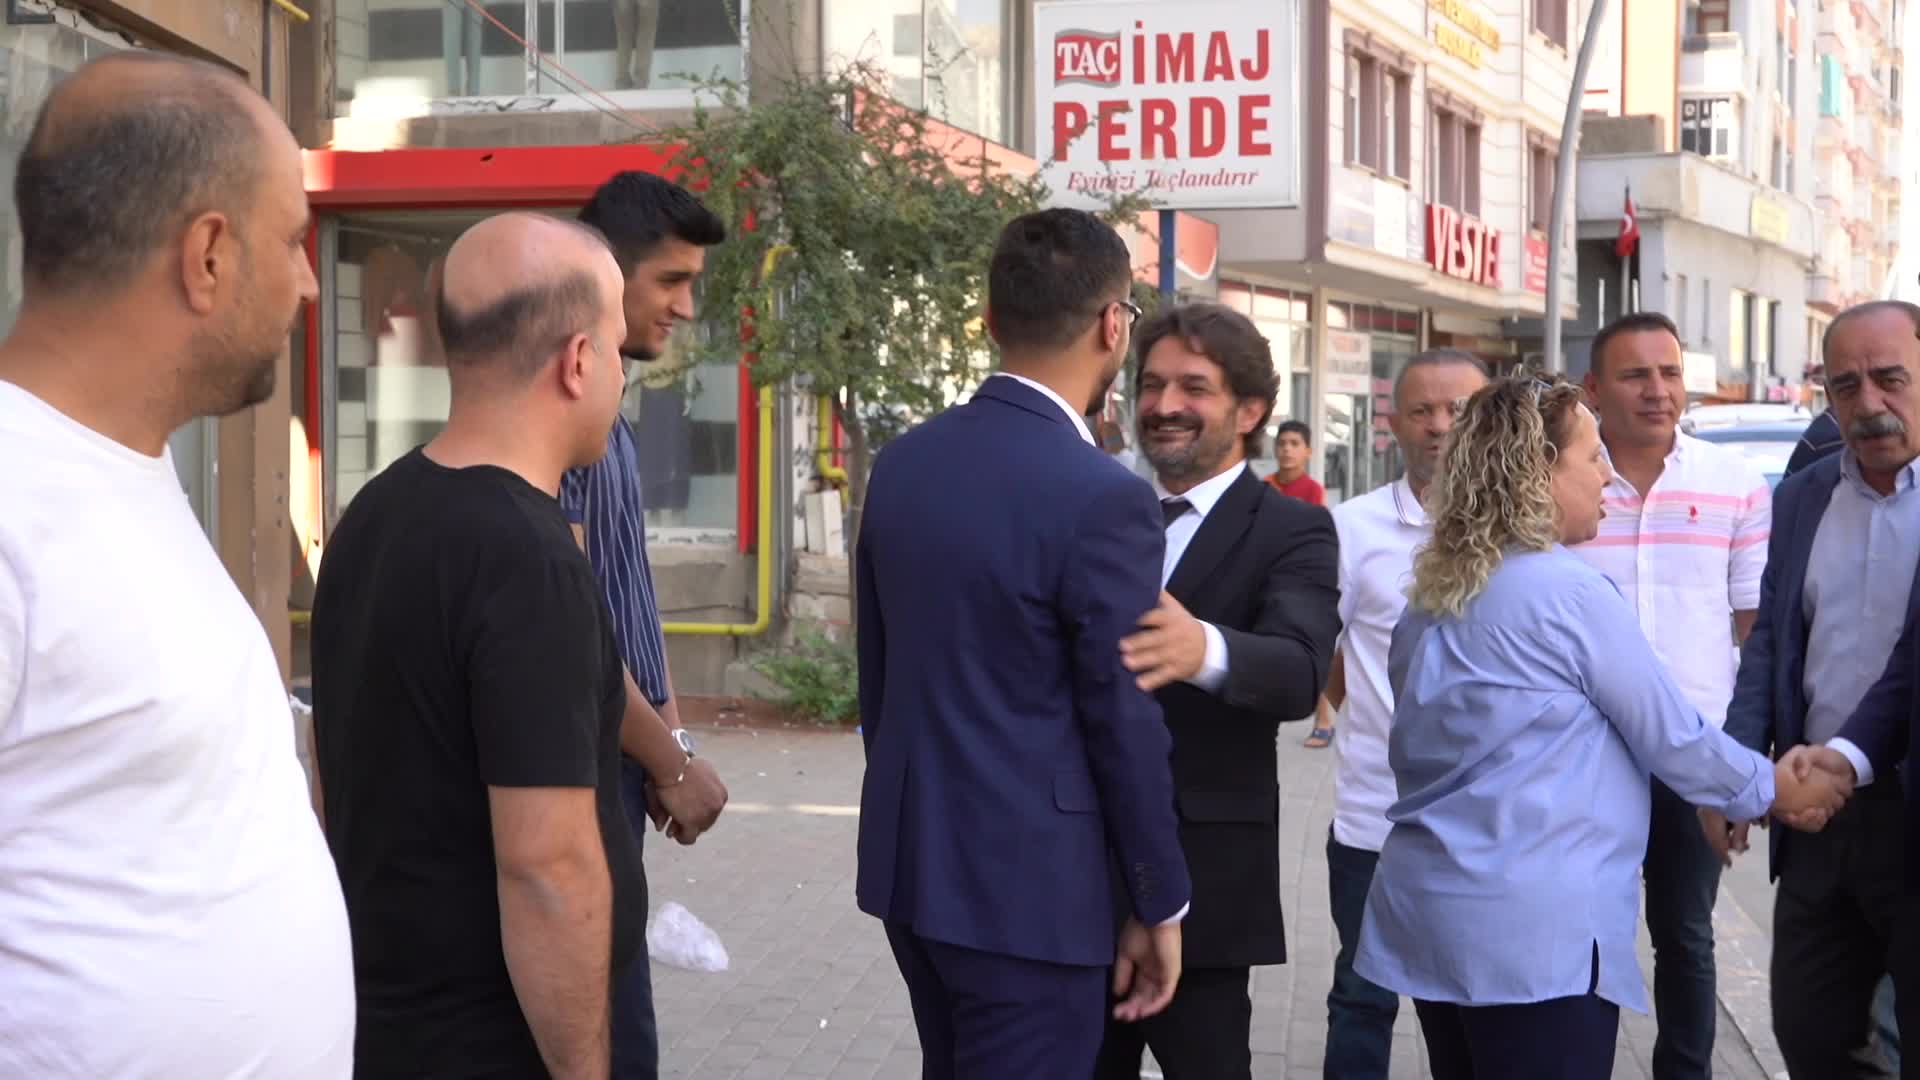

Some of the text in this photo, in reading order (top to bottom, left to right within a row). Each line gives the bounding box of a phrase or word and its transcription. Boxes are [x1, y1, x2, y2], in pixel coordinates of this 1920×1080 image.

[1057, 20, 1270, 85] TAÇ İMAJ
[1053, 94, 1272, 162] PERDE
[1432, 203, 1502, 289] VESTE
